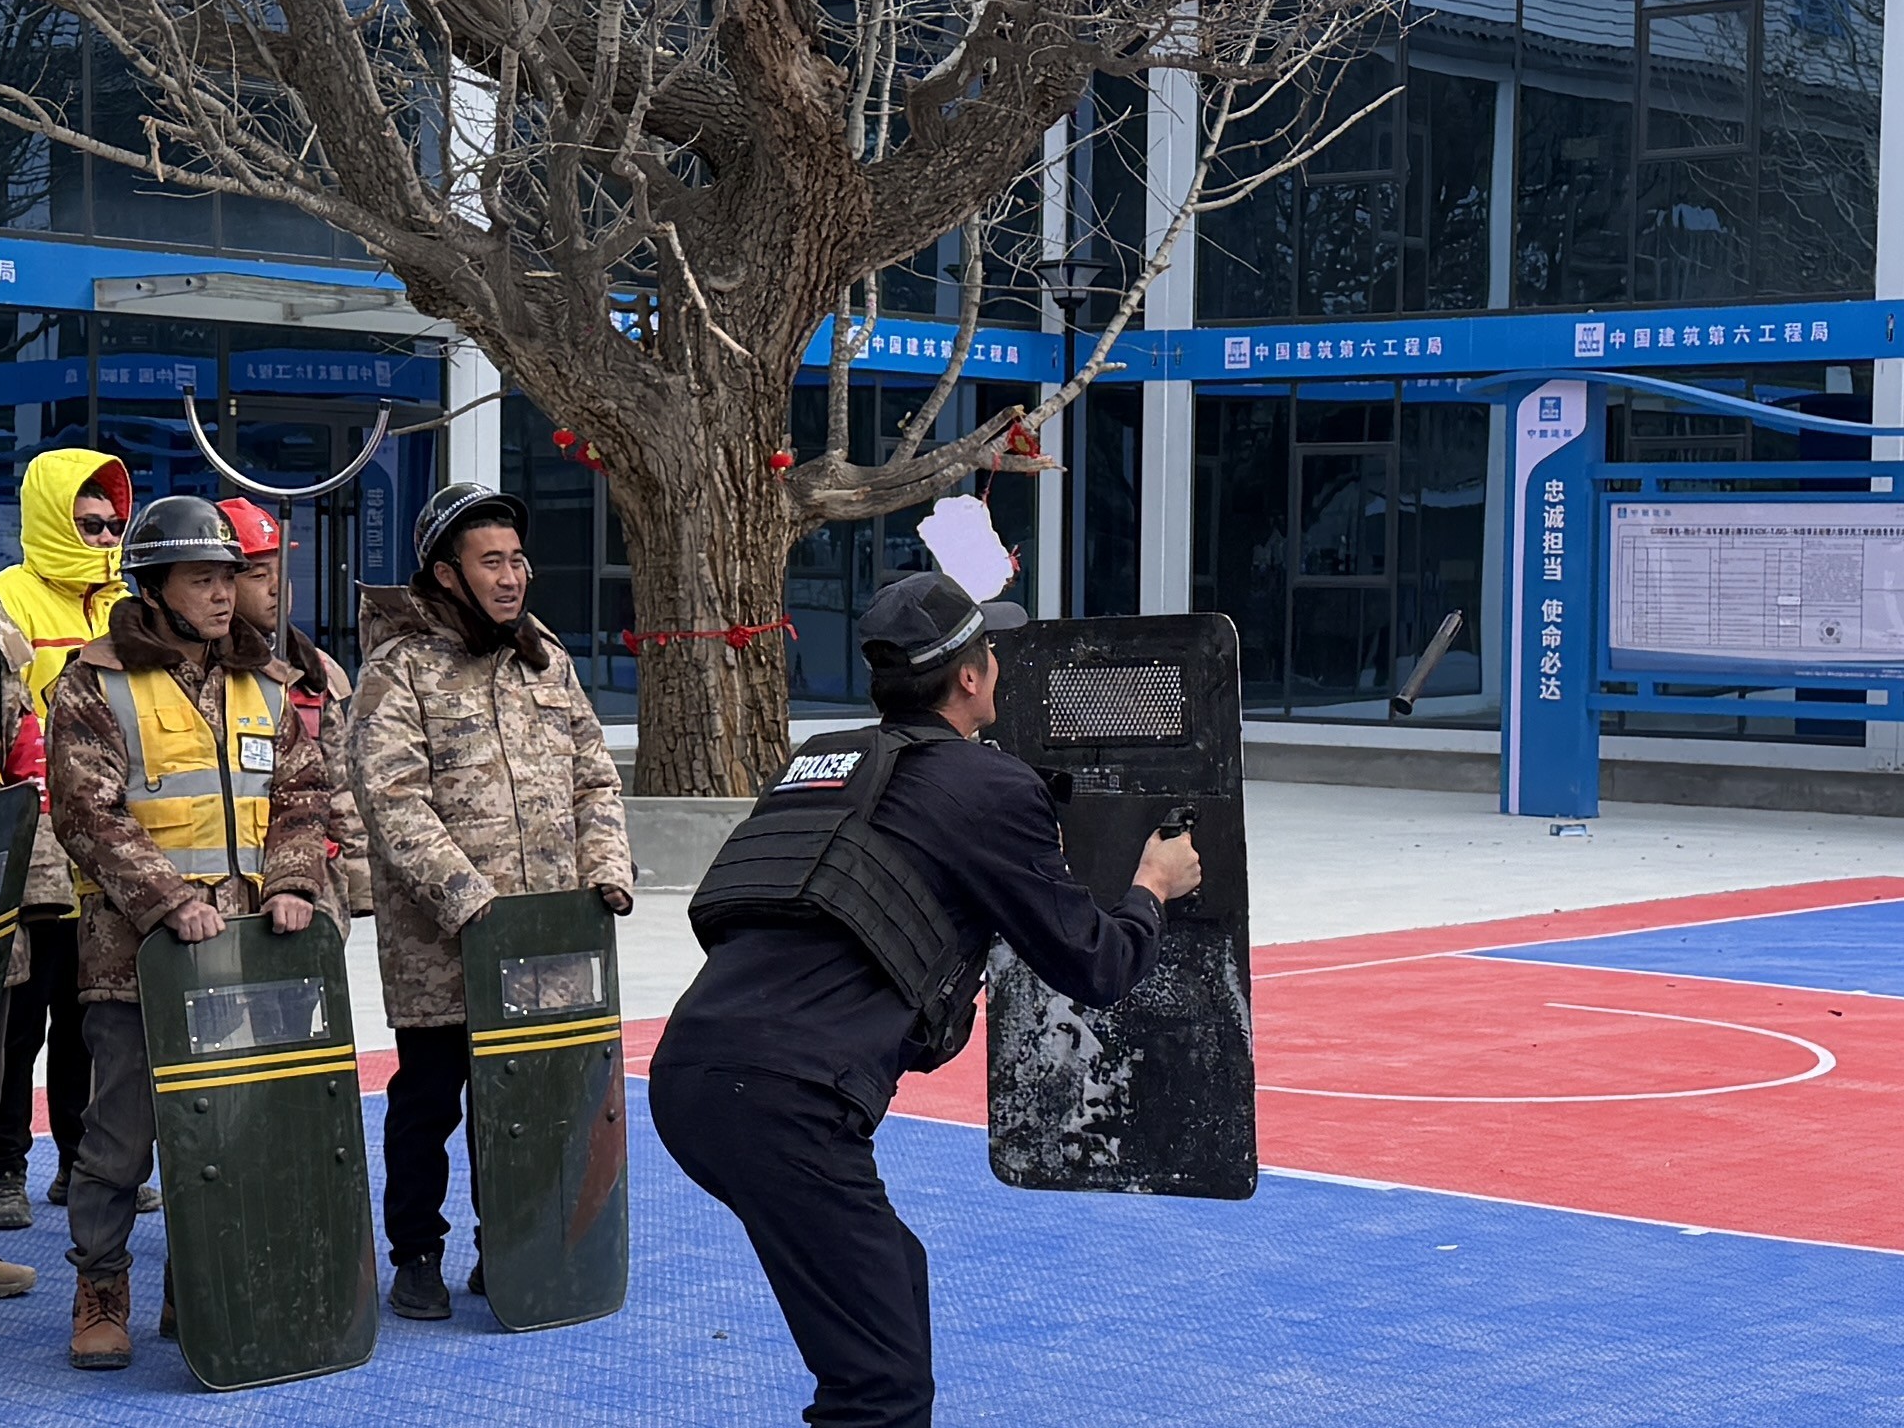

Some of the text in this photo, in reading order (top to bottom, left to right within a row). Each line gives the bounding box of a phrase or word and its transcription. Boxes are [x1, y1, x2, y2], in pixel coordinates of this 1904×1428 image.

[1255, 337, 1442, 361] 中国建筑第六工程局
[1609, 321, 1828, 349] 中国建筑第六工程局
[872, 335, 998, 365] 中国建筑第工程局
[1539, 479, 1565, 701] 忠诚担当 使命必达
